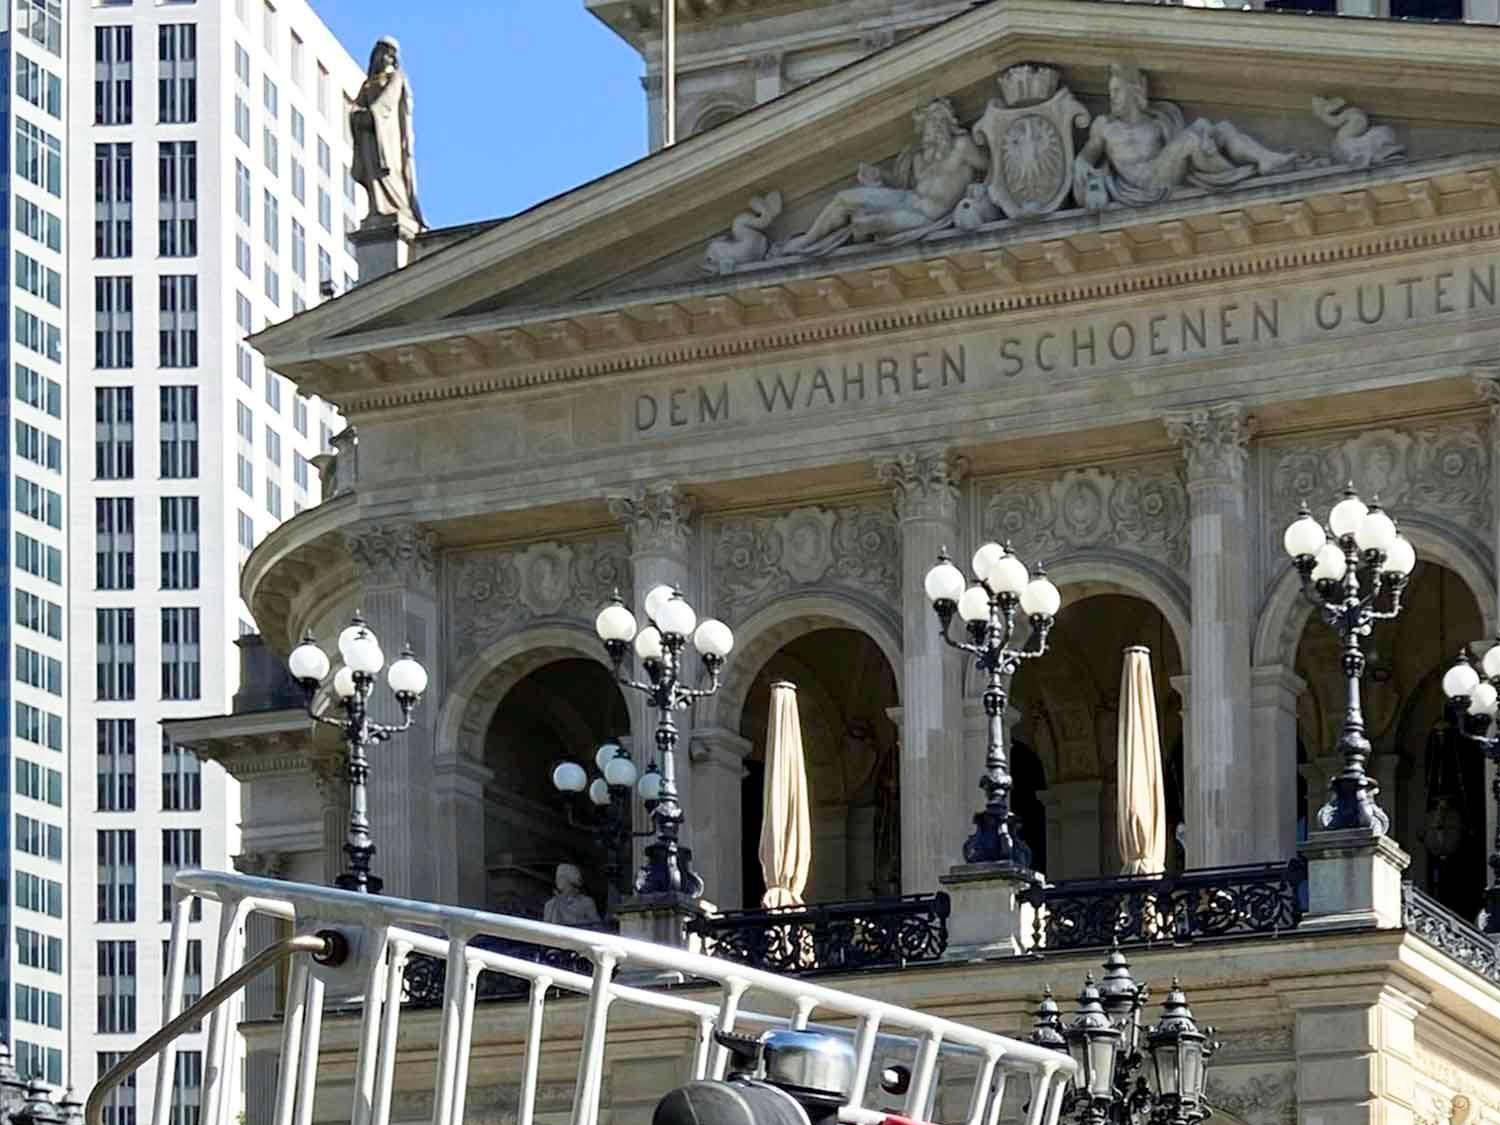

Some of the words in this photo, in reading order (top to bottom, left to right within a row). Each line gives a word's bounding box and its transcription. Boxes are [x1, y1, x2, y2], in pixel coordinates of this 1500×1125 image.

[633, 381, 730, 432] DEM
[755, 343, 968, 414] WAHREN
[999, 298, 1283, 378] SCHOENEN
